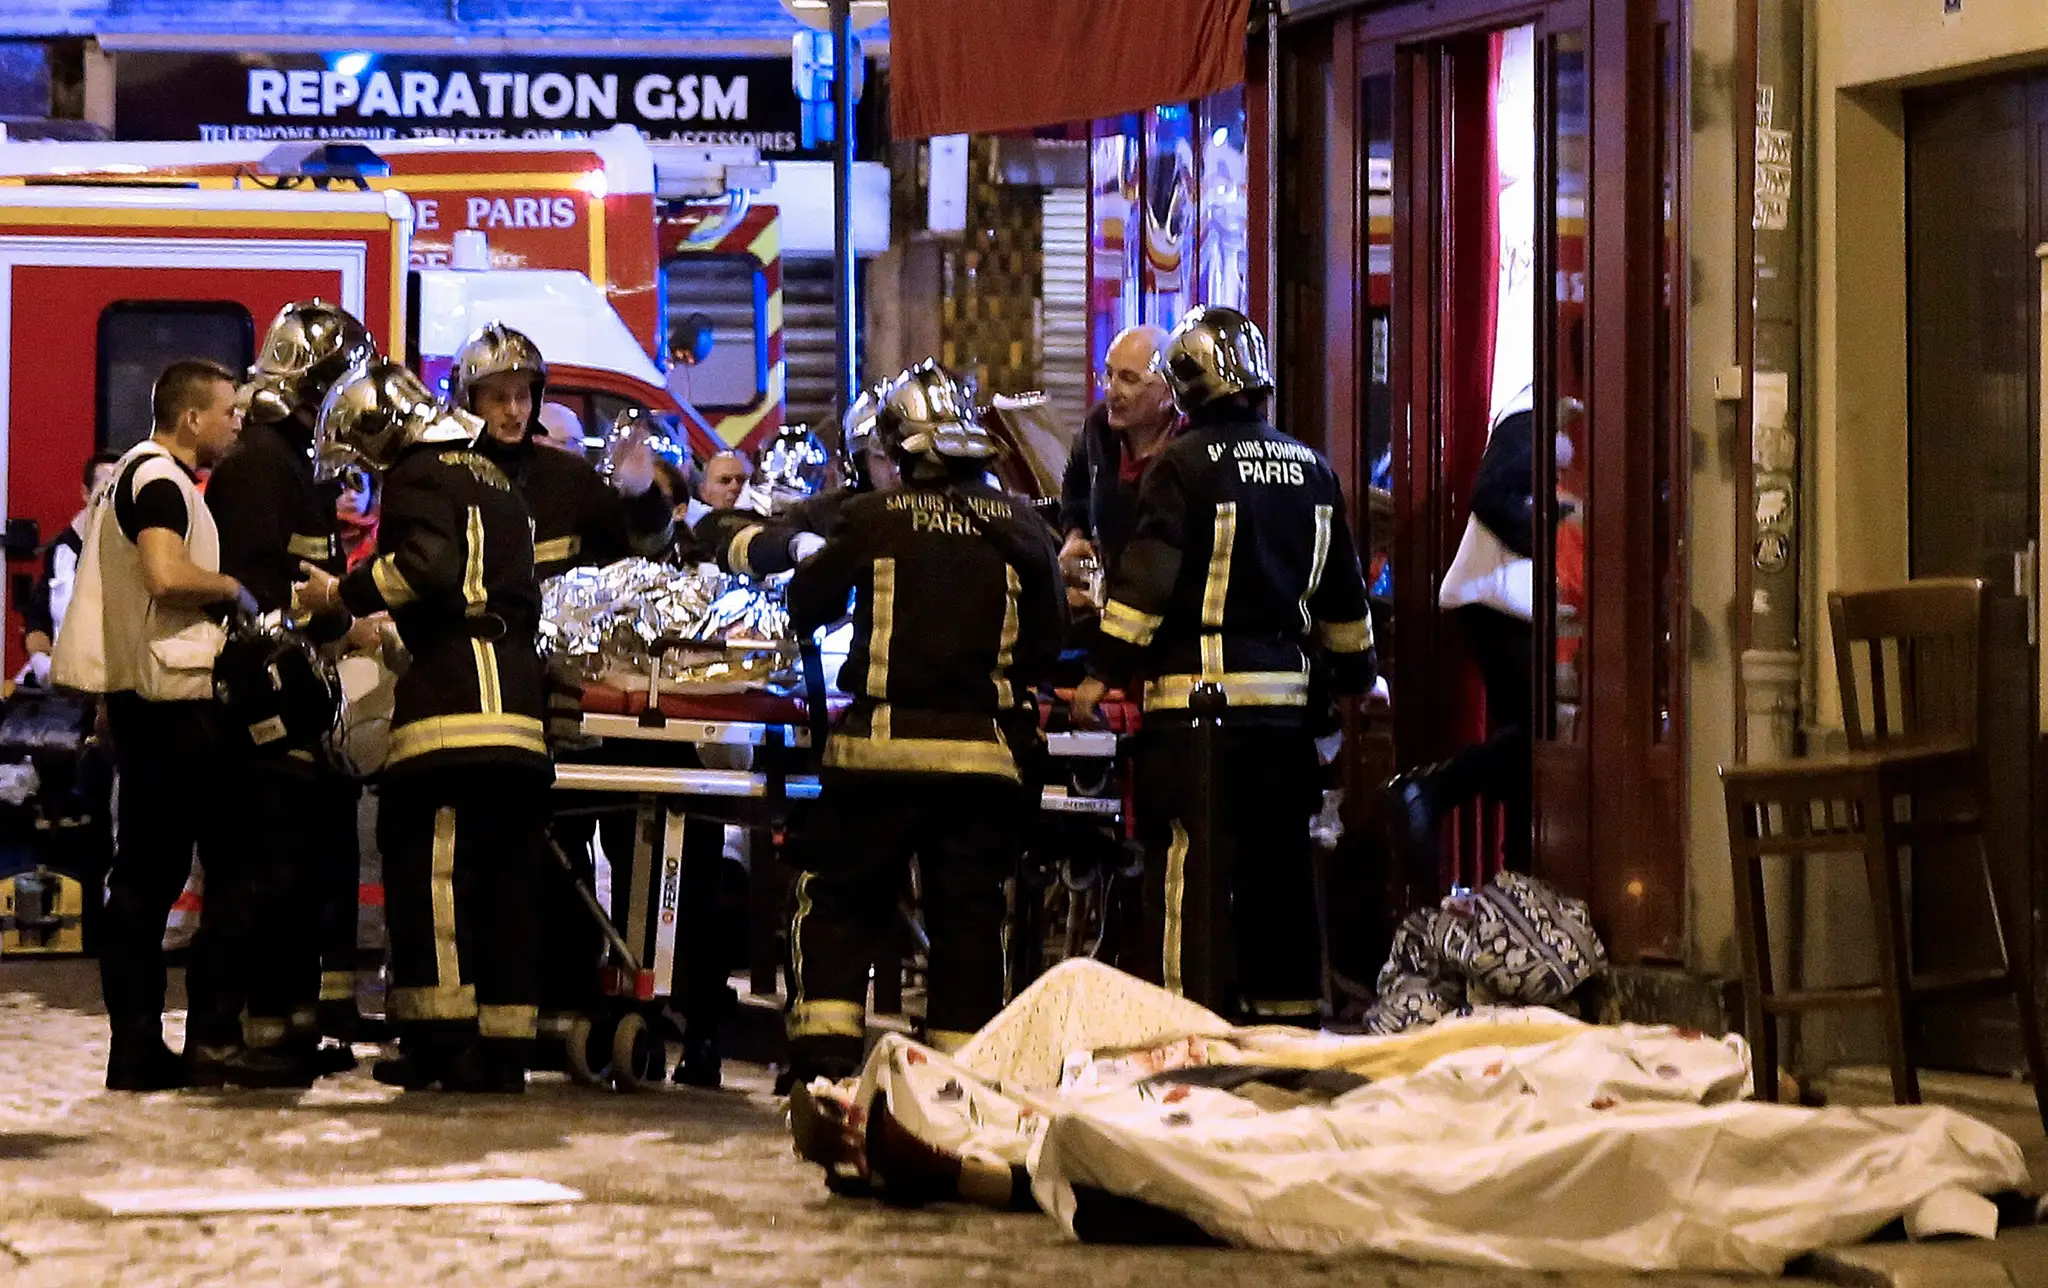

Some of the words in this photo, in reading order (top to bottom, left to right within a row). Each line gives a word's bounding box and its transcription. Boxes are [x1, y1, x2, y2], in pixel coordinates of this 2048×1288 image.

[248, 69, 618, 120] REPARATION
[633, 74, 748, 121] GSM
[415, 199, 440, 230] E
[466, 196, 577, 229] PARIS
[1237, 460, 1305, 486] PARIS
